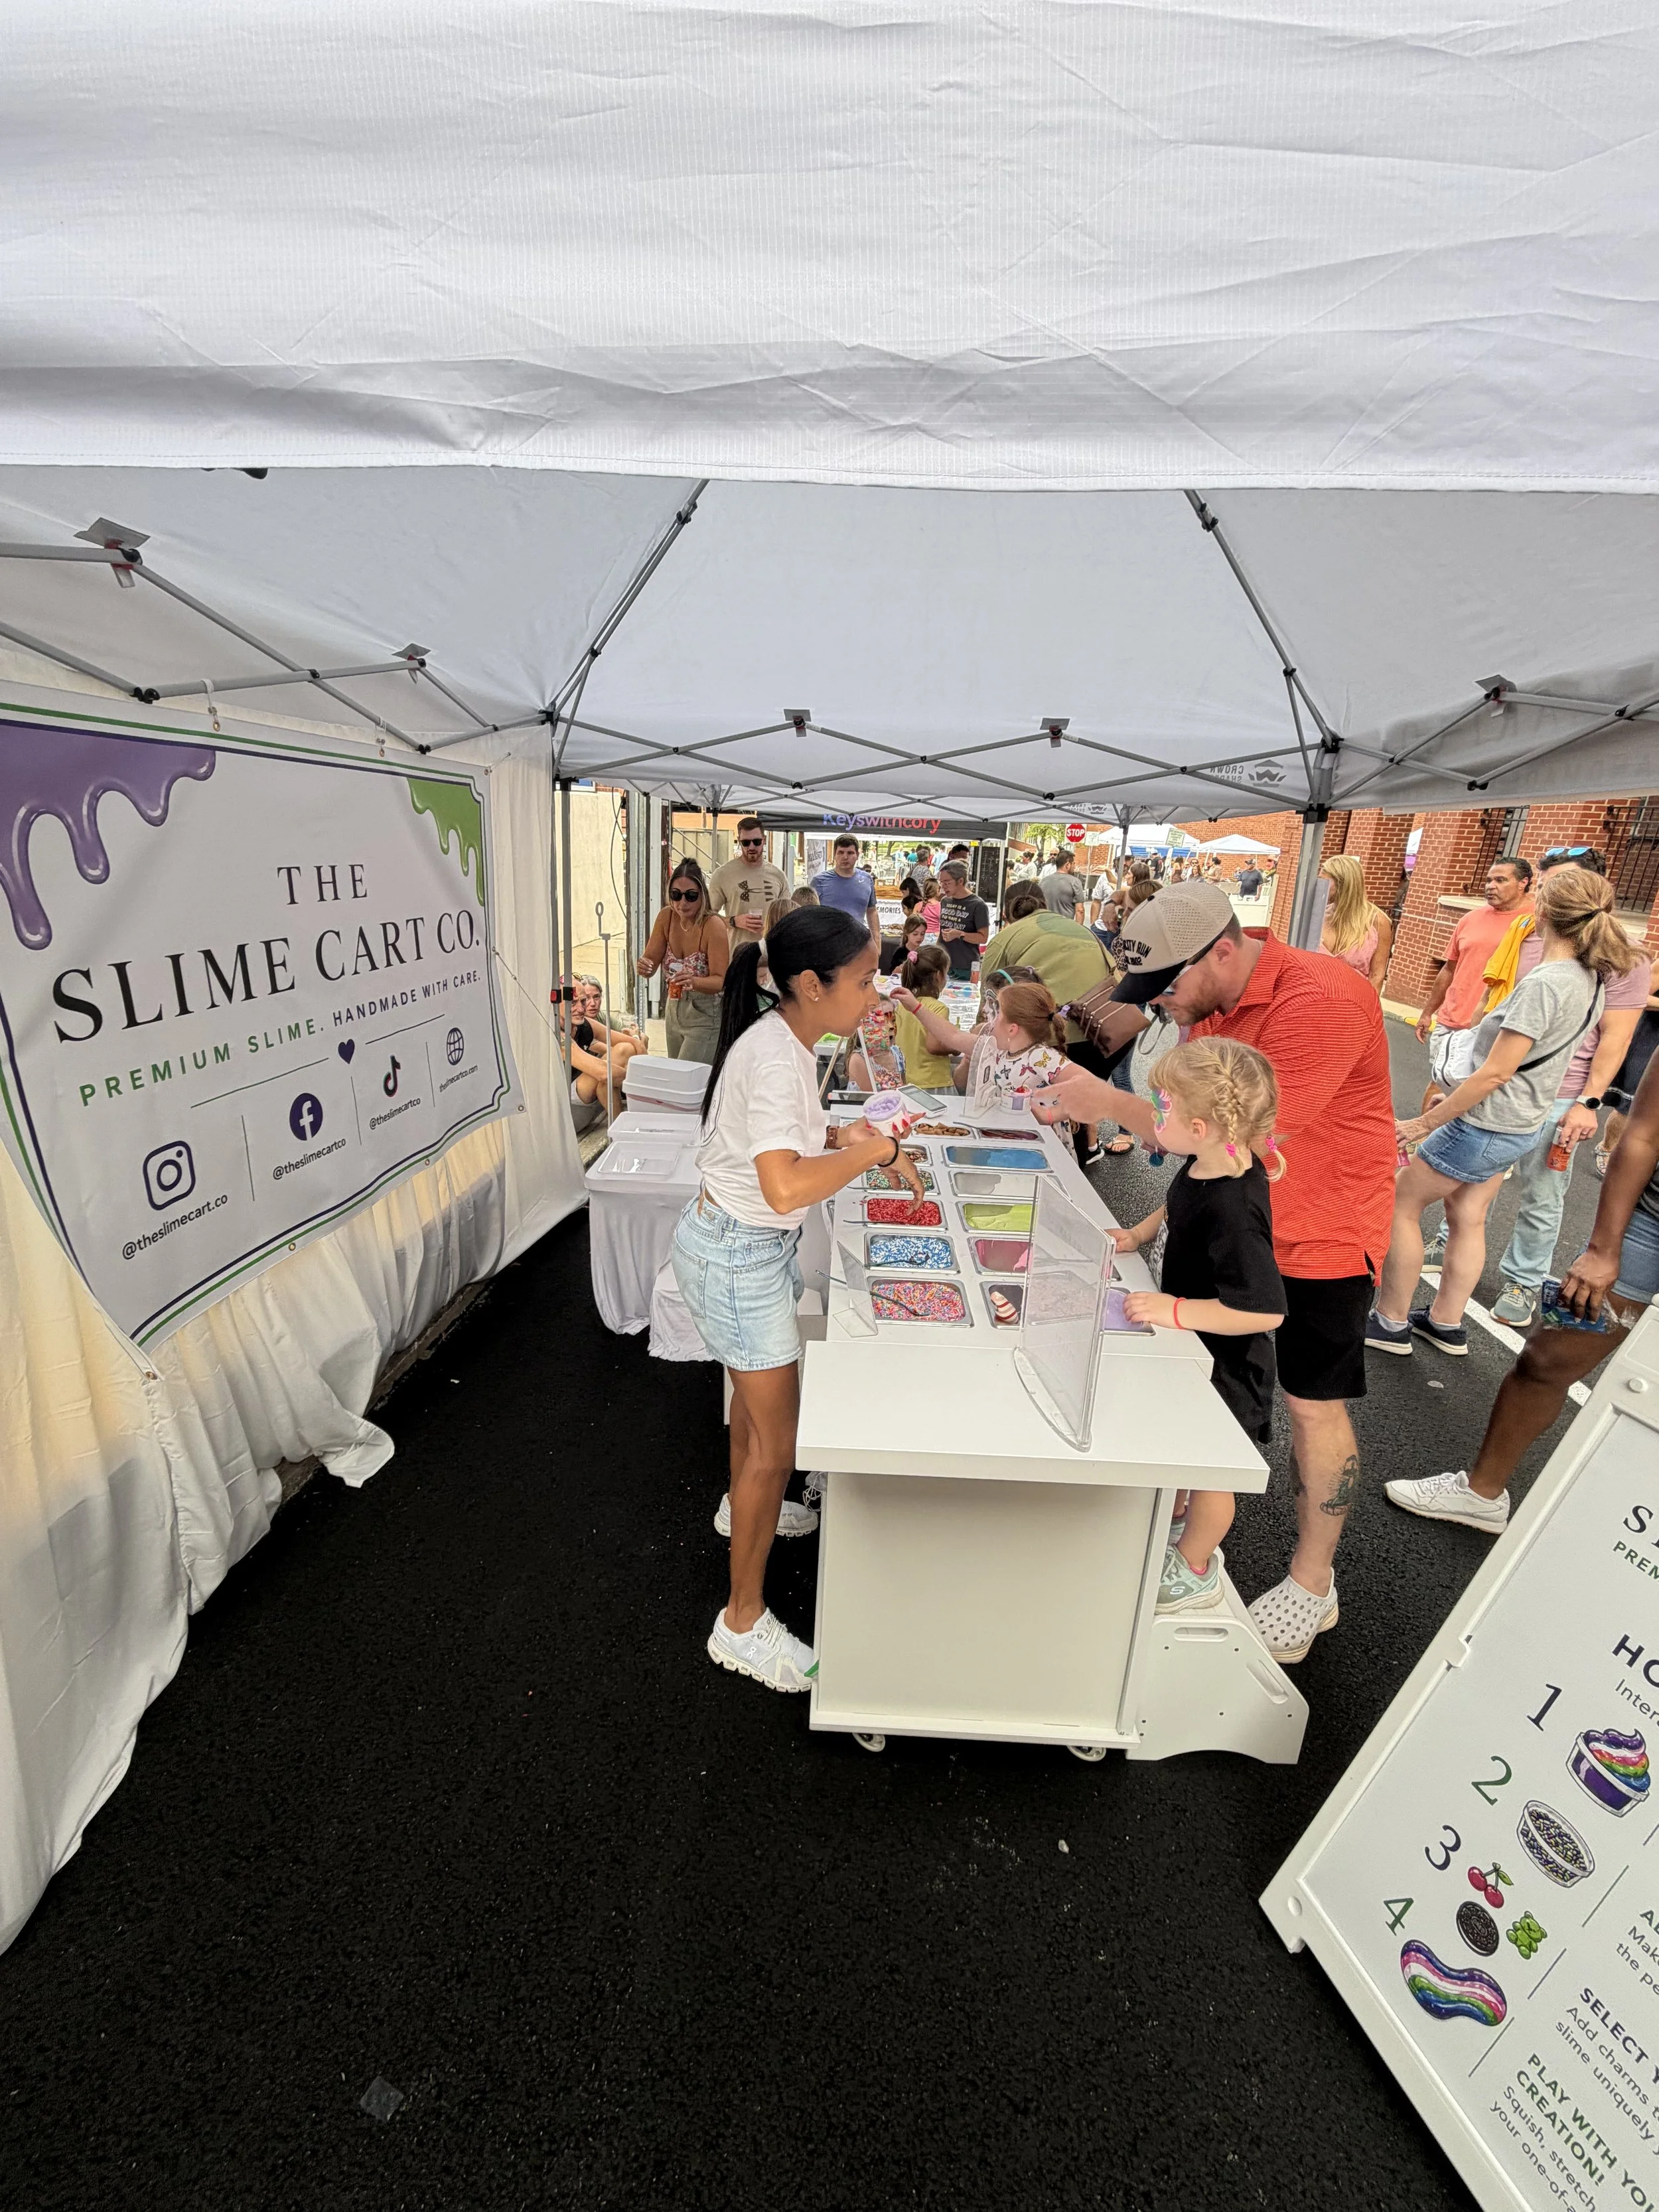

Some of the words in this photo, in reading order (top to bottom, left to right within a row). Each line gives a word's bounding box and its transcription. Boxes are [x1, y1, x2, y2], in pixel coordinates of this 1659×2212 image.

[1066, 828, 1086, 838] STOP
[277, 864, 368, 905] THE
[1136, 941, 1151, 958] RUN
[52, 938, 295, 1043] SLIME
[315, 917, 425, 981] CART
[437, 910, 480, 954] CO.
[79, 1043, 231, 1107] PREMIUM
[248, 1018, 325, 1054] SLIME.
[332, 989, 417, 1027] HANDMADE
[421, 978, 448, 999] WITH
[453, 970, 481, 989] CARE.
[369, 1097, 421, 1130] @theslimecartco
[273, 1138, 347, 1181] @theslimecartco
[122, 1195, 228, 1260] @theslimecart.co
[1526, 1684, 1562, 1732] 1
[1471, 1755, 1512, 1806] 2
[1425, 1825, 1461, 1871] 3
[1384, 1897, 1414, 1936] 4
[1616, 1943, 1639, 1970] the
[1579, 1988, 1649, 2064] SELECT
[1566, 2007, 1599, 2041] Add
[1598, 2044, 1649, 2105] charms
[1555, 2022, 1591, 2065] slime
[1593, 2066, 1654, 2140] uniquely
[1490, 2100, 1521, 2138] your
[1503, 2086, 1546, 2150] Squish,
[1516, 2070, 1605, 2187] CREATION!
[1528, 2053, 1571, 2105] PLAY
[1571, 2106, 1617, 2169] WITH
